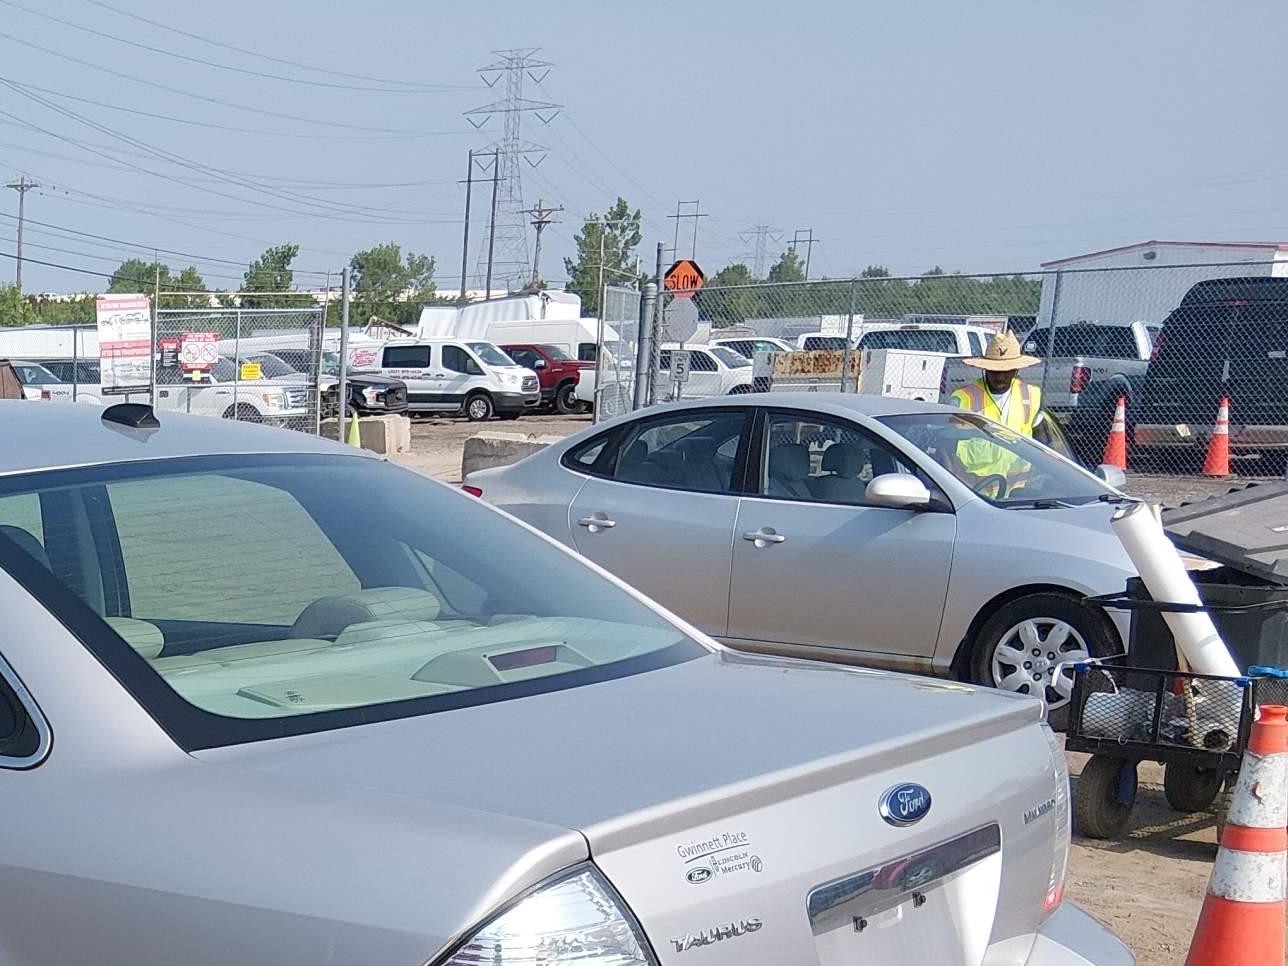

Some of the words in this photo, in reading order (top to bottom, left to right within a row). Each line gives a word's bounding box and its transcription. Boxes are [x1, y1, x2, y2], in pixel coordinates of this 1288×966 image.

[670, 274, 698, 289] SLOW
[676, 363, 685, 375] 5
[898, 789, 924, 816] Ford
[677, 836, 722, 858] Gwinnett
[721, 831, 749, 846] Place
[717, 851, 750, 866] LINCOLN
[720, 860, 751, 875] Mercury
[670, 918, 763, 953] TAURUS
